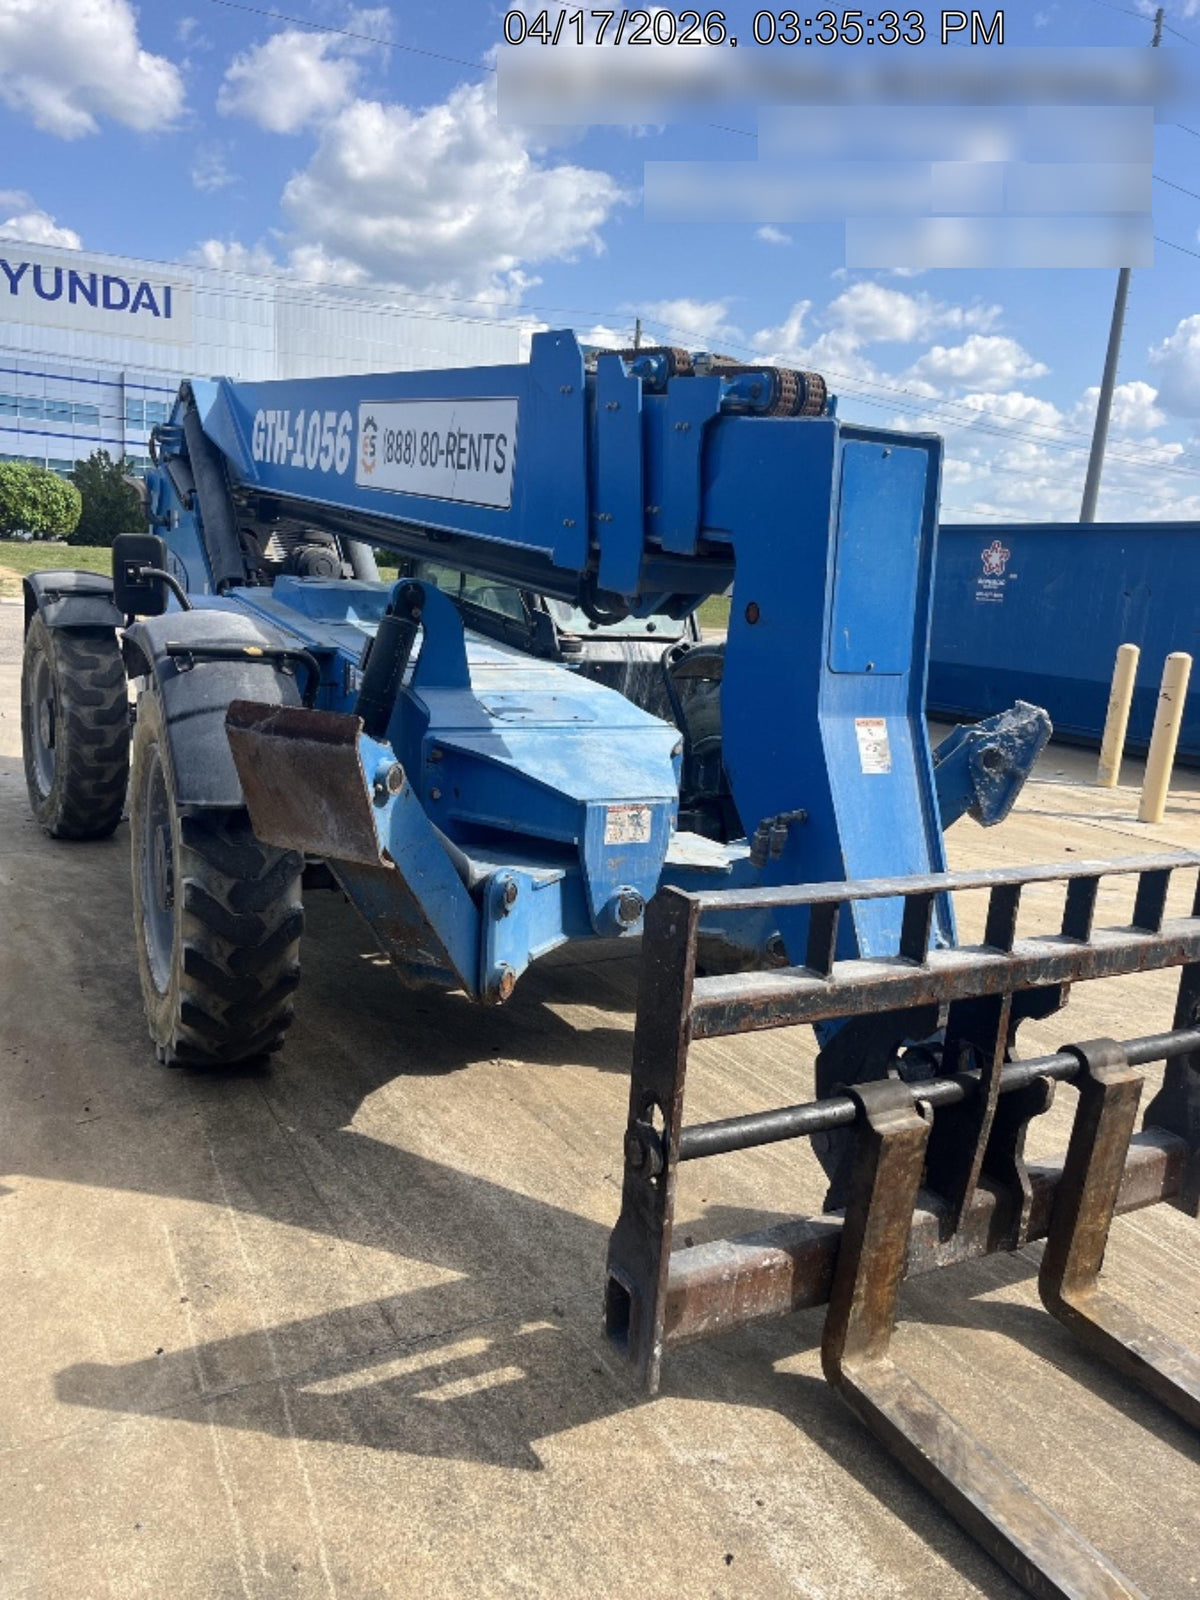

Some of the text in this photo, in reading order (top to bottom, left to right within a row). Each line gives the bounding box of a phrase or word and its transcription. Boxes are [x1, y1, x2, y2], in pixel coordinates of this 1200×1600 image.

[0, 259, 172, 318] YUNDAI
[252, 408, 353, 475] GTH-1056
[383, 428, 508, 474] (888) 80-RENTS
